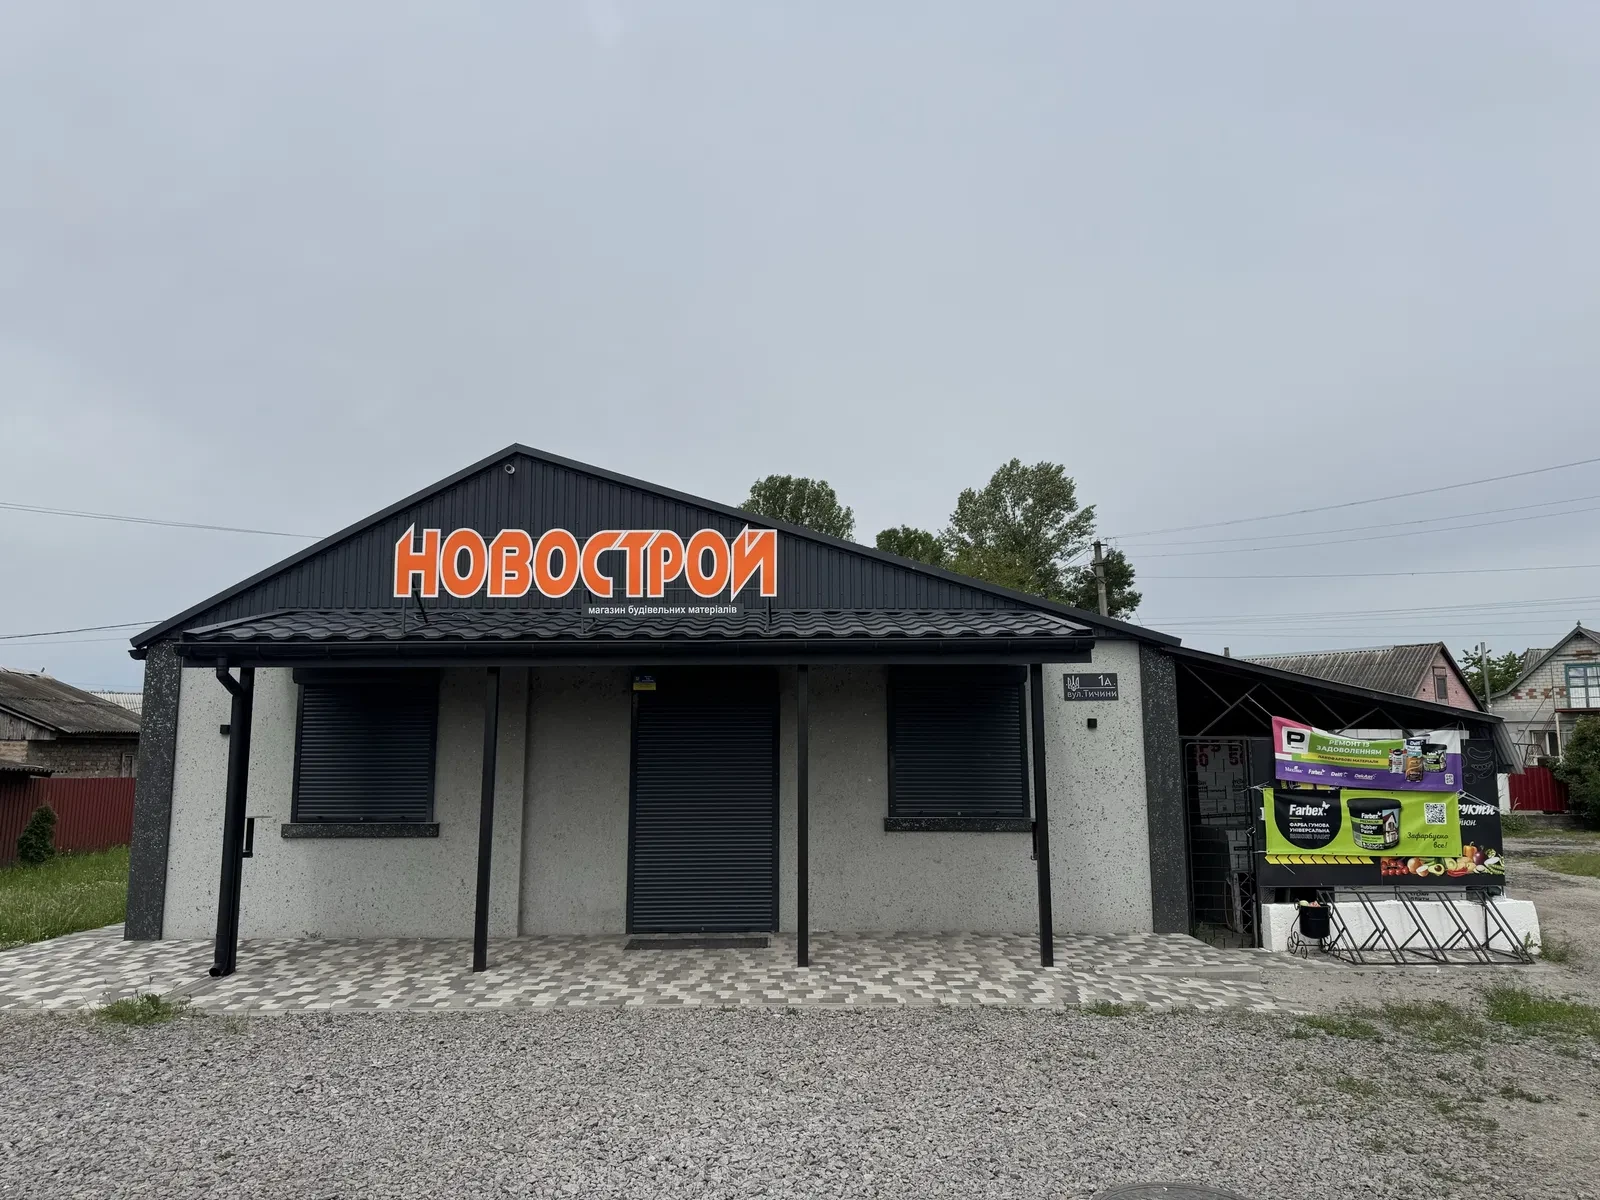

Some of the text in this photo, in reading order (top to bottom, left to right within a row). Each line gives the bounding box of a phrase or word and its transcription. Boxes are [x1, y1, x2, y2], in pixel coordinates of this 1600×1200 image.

[394, 522, 777, 602] НОВОСТРОЙ
[588, 605, 738, 616] магазин будівельних матеріалів
[1329, 739, 1362, 747] РЕМОНТ
[1316, 745, 1382, 755] ЗАДОВОЛЕННЯМ
